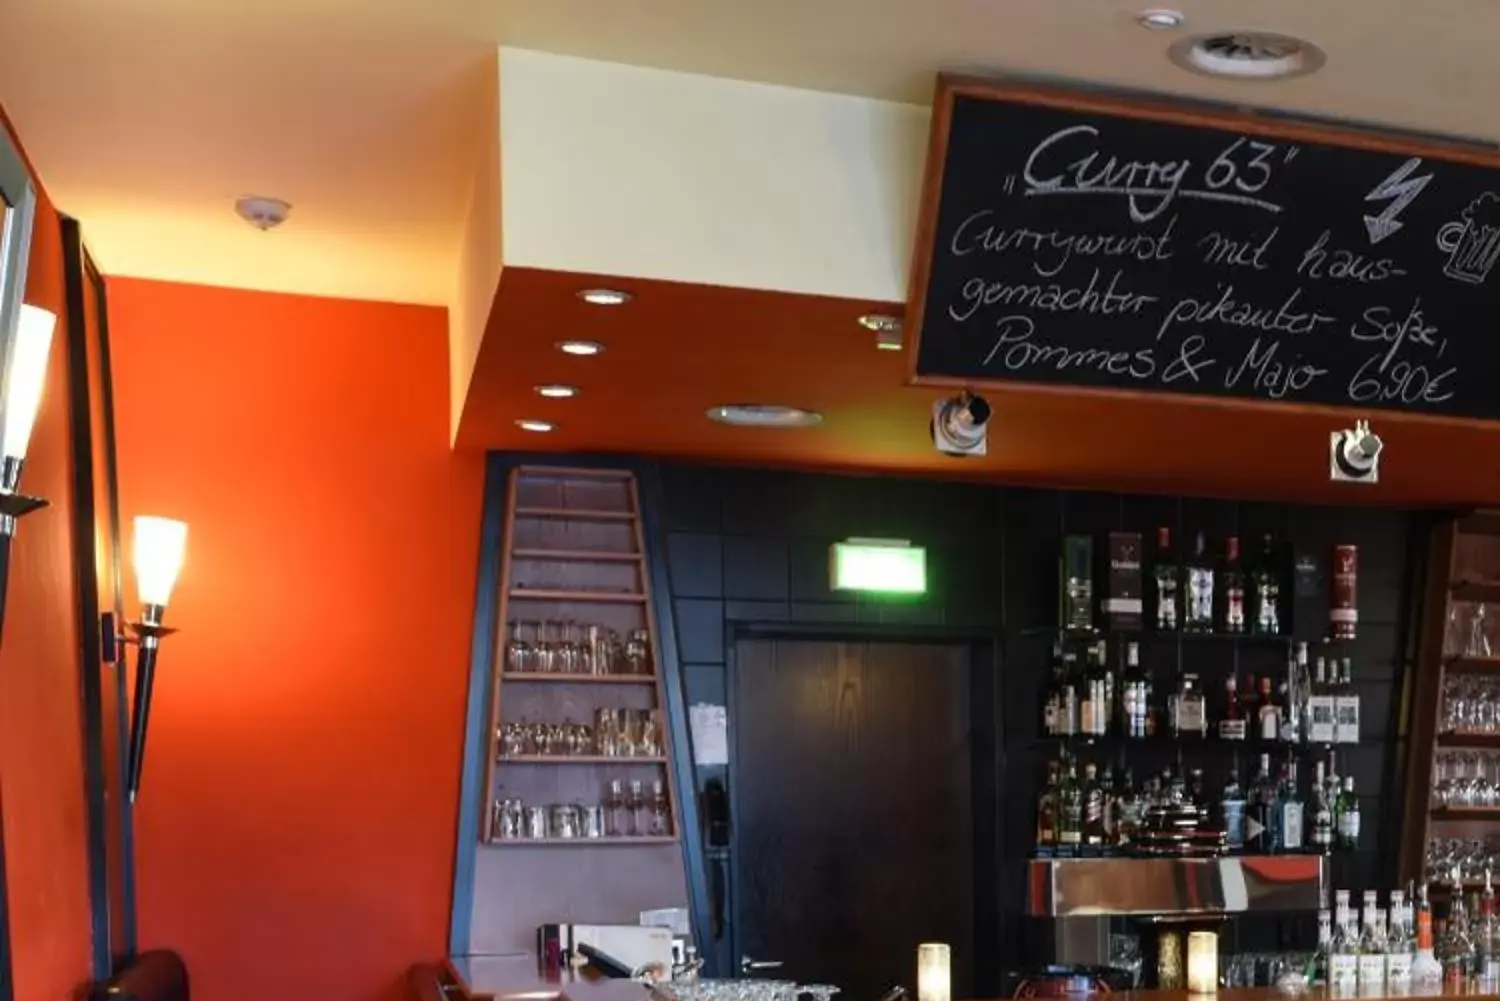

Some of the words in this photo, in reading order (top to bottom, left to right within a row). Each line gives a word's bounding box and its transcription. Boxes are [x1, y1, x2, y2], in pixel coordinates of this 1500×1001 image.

[951, 209, 1179, 277] Currywurst
[1200, 226, 1279, 271] mit
[1297, 229, 1408, 281] haus-
[949, 267, 1158, 321] gemachter
[982, 315, 1156, 378] Pommes
[1162, 335, 1217, 383] &
[1224, 338, 1330, 398] Majo
